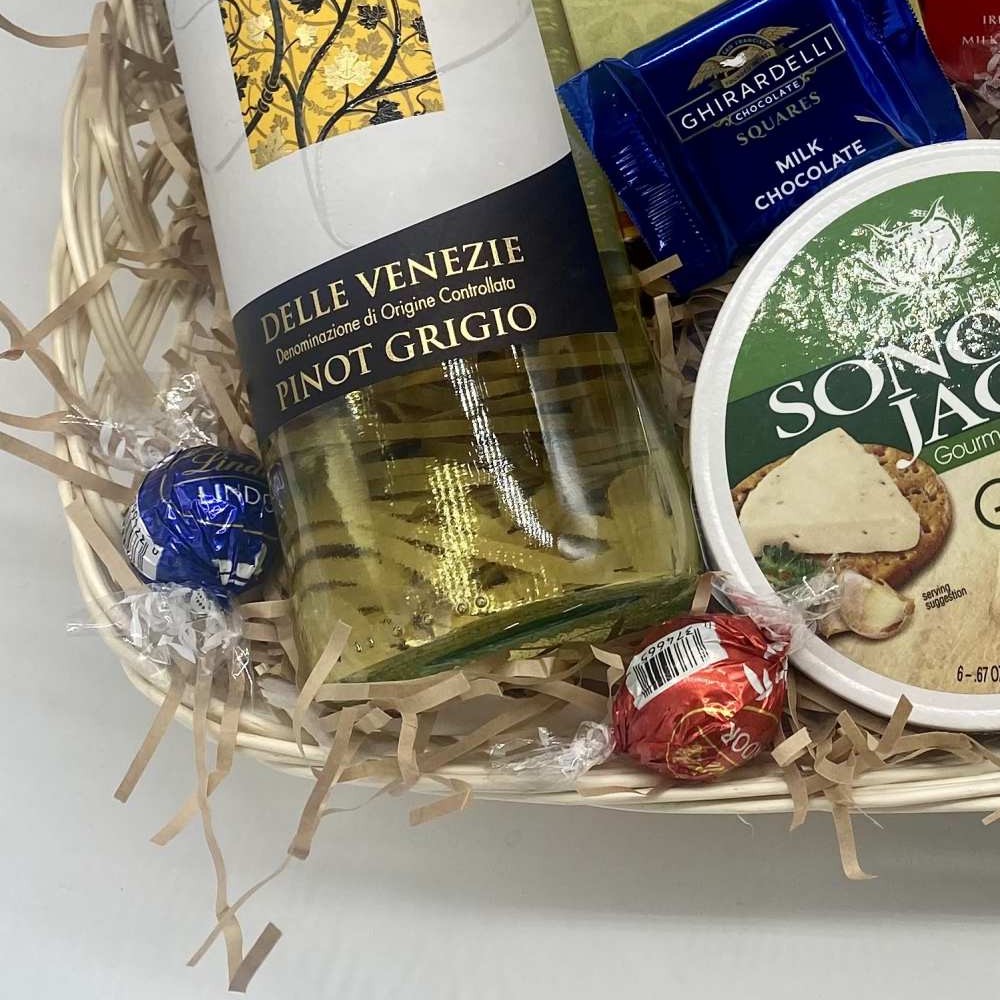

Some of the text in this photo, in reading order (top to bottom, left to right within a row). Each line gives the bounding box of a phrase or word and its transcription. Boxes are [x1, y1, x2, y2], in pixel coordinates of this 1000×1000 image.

[680, 35, 834, 131] GHIRARDELLI
[734, 78, 802, 123] CHOCOLATE
[736, 90, 822, 147] SQUARES
[753, 138, 868, 212] CHOCOLATE
[775, 138, 825, 175] MILK
[260, 235, 526, 345] DELLE VENEZIE
[276, 276, 516, 366] Denominazione di Origine Controllata
[275, 303, 538, 412] PINOT GRIGIO
[921, 582, 951, 602] serving
[924, 586, 968, 611] suggestion
